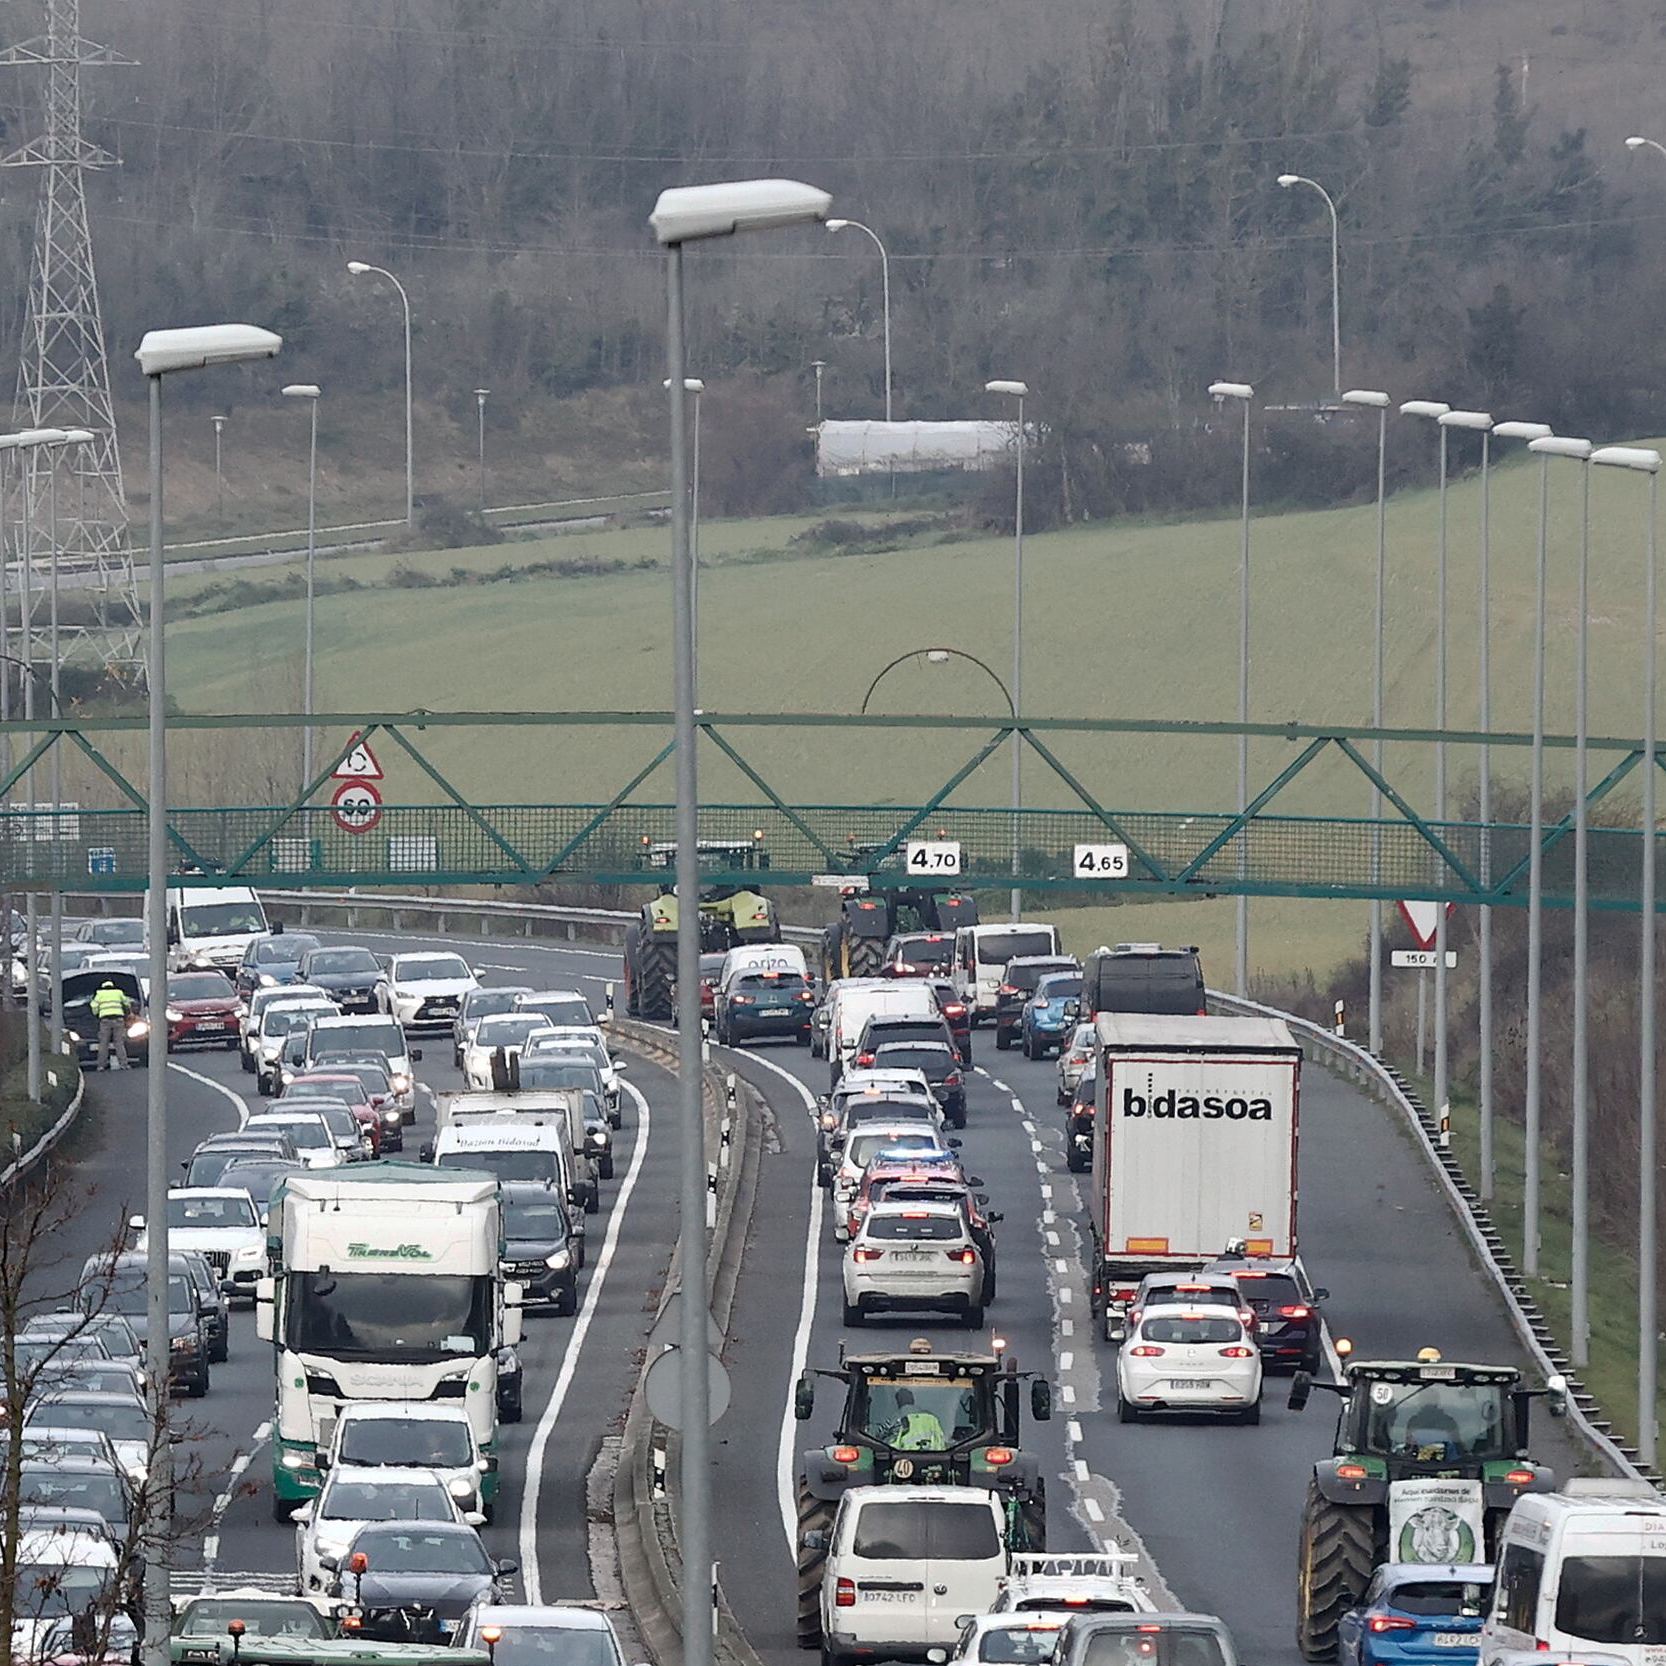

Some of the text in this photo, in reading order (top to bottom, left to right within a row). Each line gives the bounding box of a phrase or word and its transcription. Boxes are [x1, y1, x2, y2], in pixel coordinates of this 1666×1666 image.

[911, 847, 957, 869] 4.70
[1078, 850, 1124, 873] 4.65
[1405, 954, 1428, 964] 150
[1123, 1073, 1272, 1120] bidasoa
[897, 1460, 910, 1476] 40
